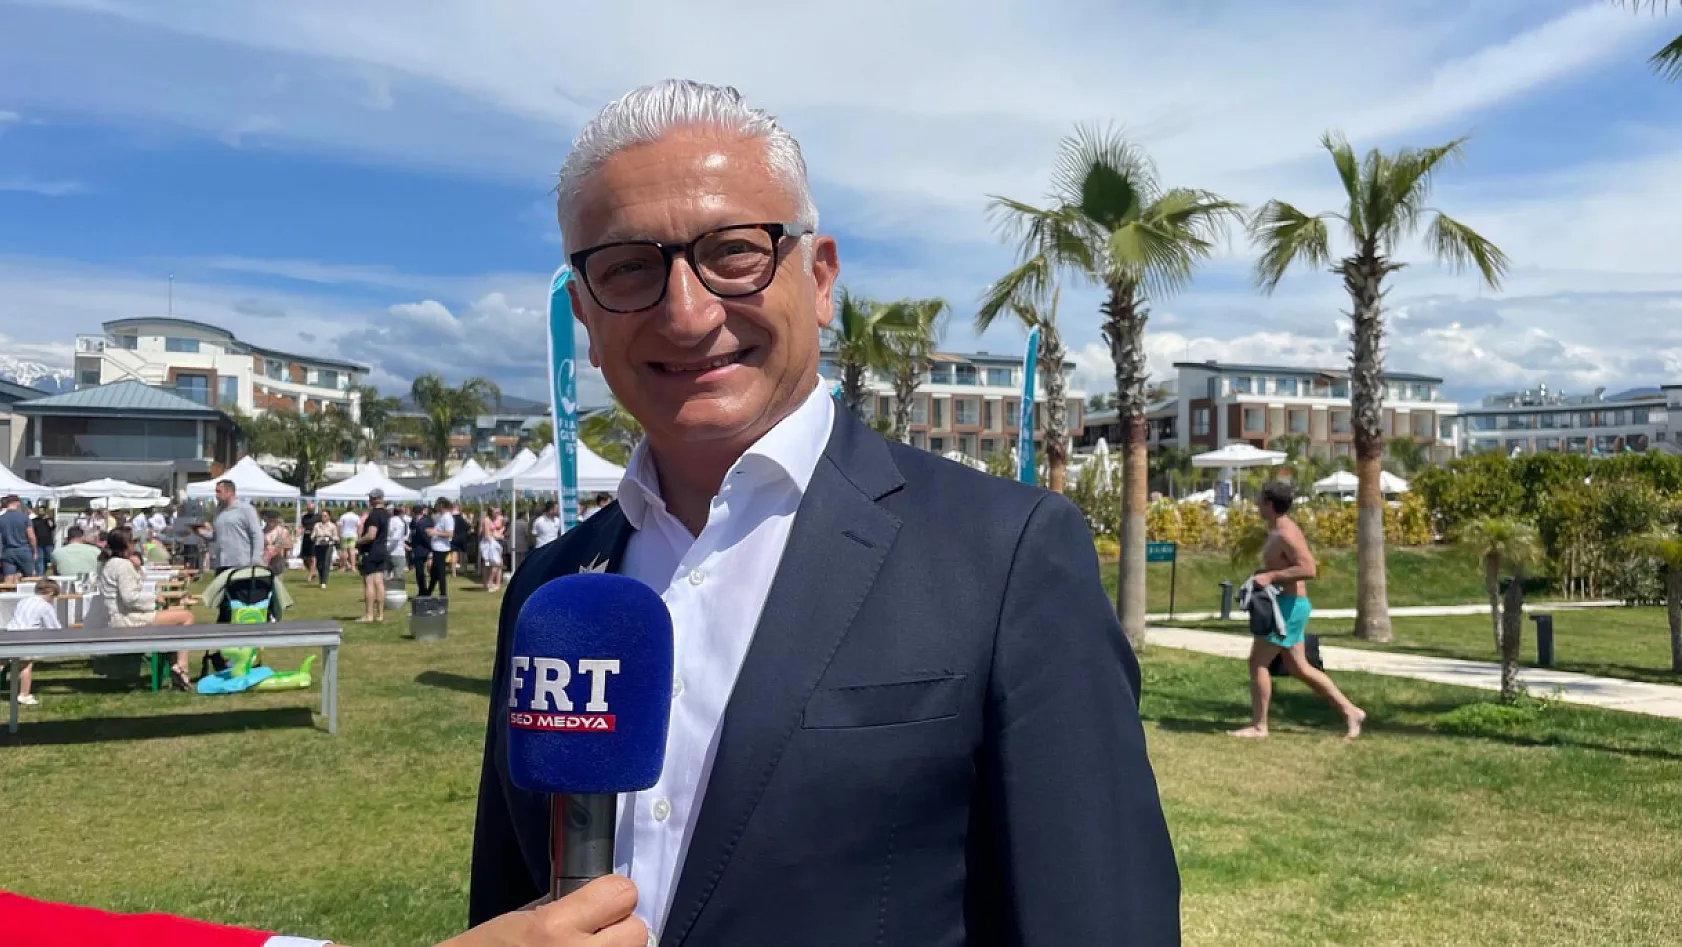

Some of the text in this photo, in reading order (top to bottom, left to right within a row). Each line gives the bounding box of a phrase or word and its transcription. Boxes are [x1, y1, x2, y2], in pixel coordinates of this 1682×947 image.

[508, 656, 620, 712] FRT
[510, 713, 608, 729] SED MEDYA
